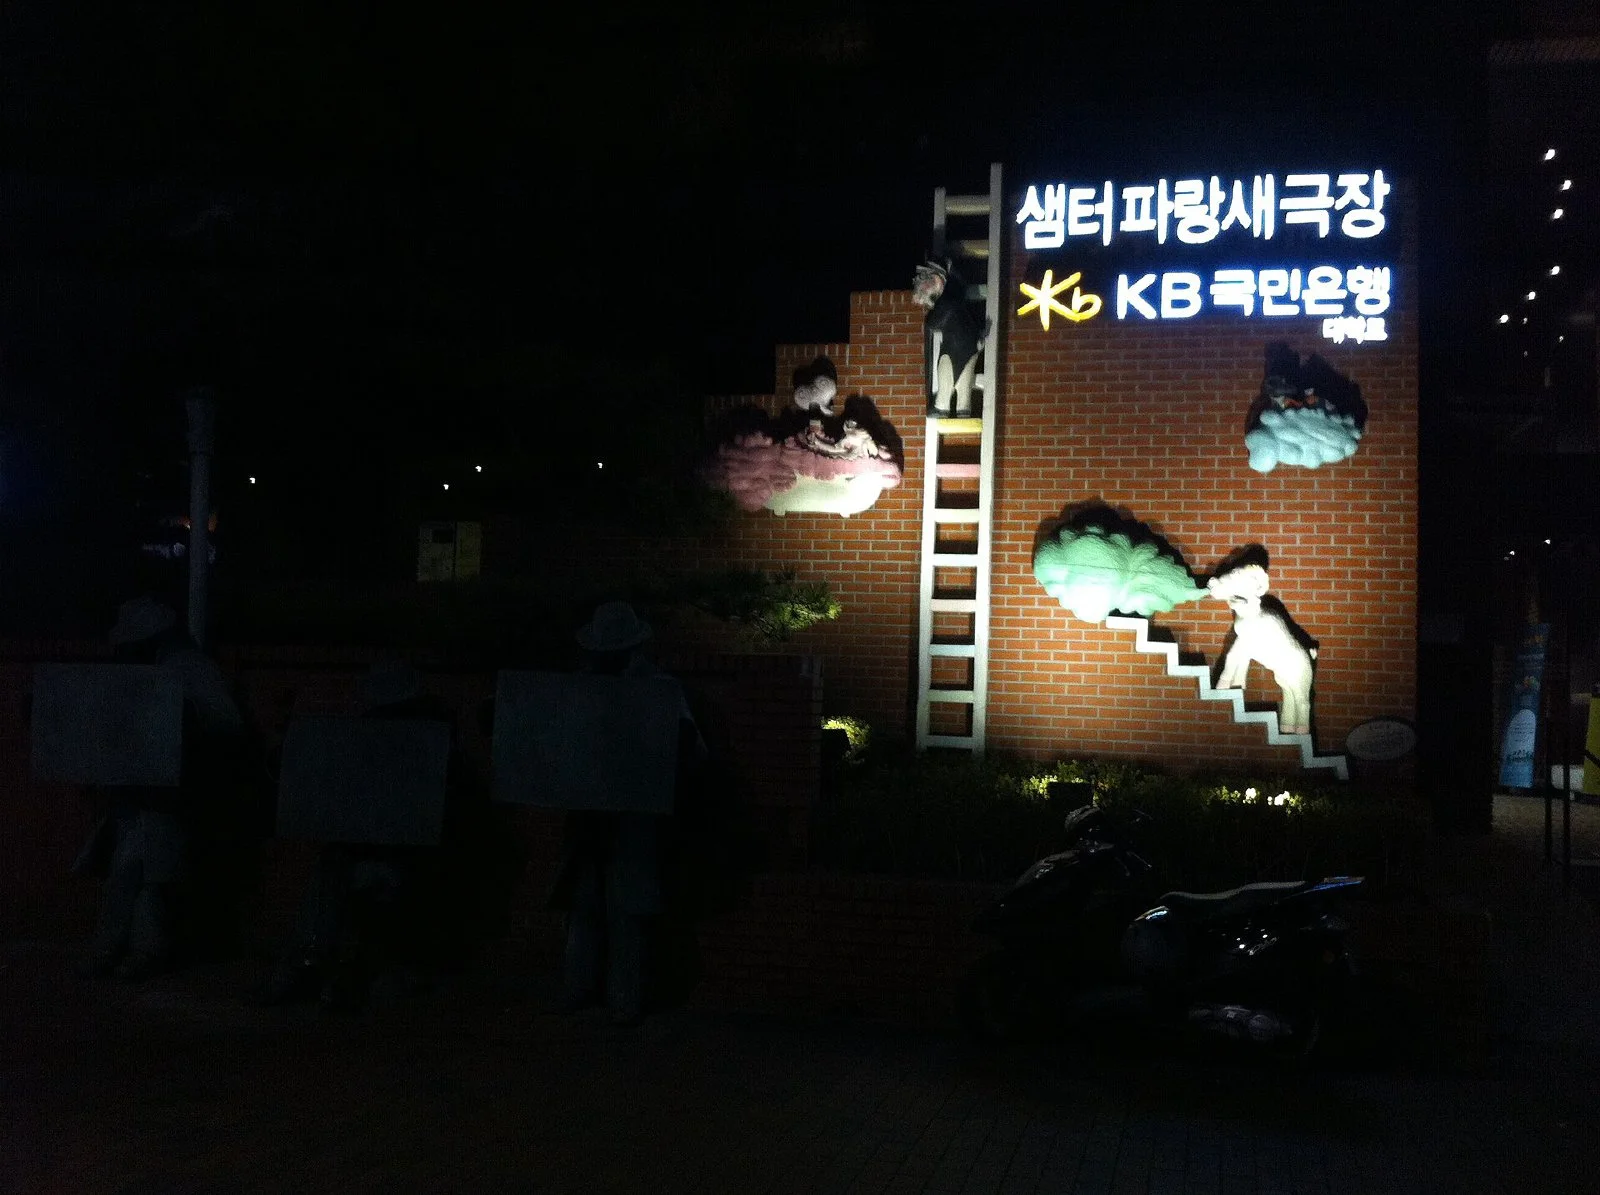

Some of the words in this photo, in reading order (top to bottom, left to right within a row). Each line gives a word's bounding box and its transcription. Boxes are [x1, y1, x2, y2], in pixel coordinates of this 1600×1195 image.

[1016, 181, 1113, 249] 샘터
[1119, 174, 1275, 244] 파랑새
[1279, 169, 1391, 240] 극장
[1116, 272, 1202, 320] KB
[1209, 265, 1391, 316] 국민은행
